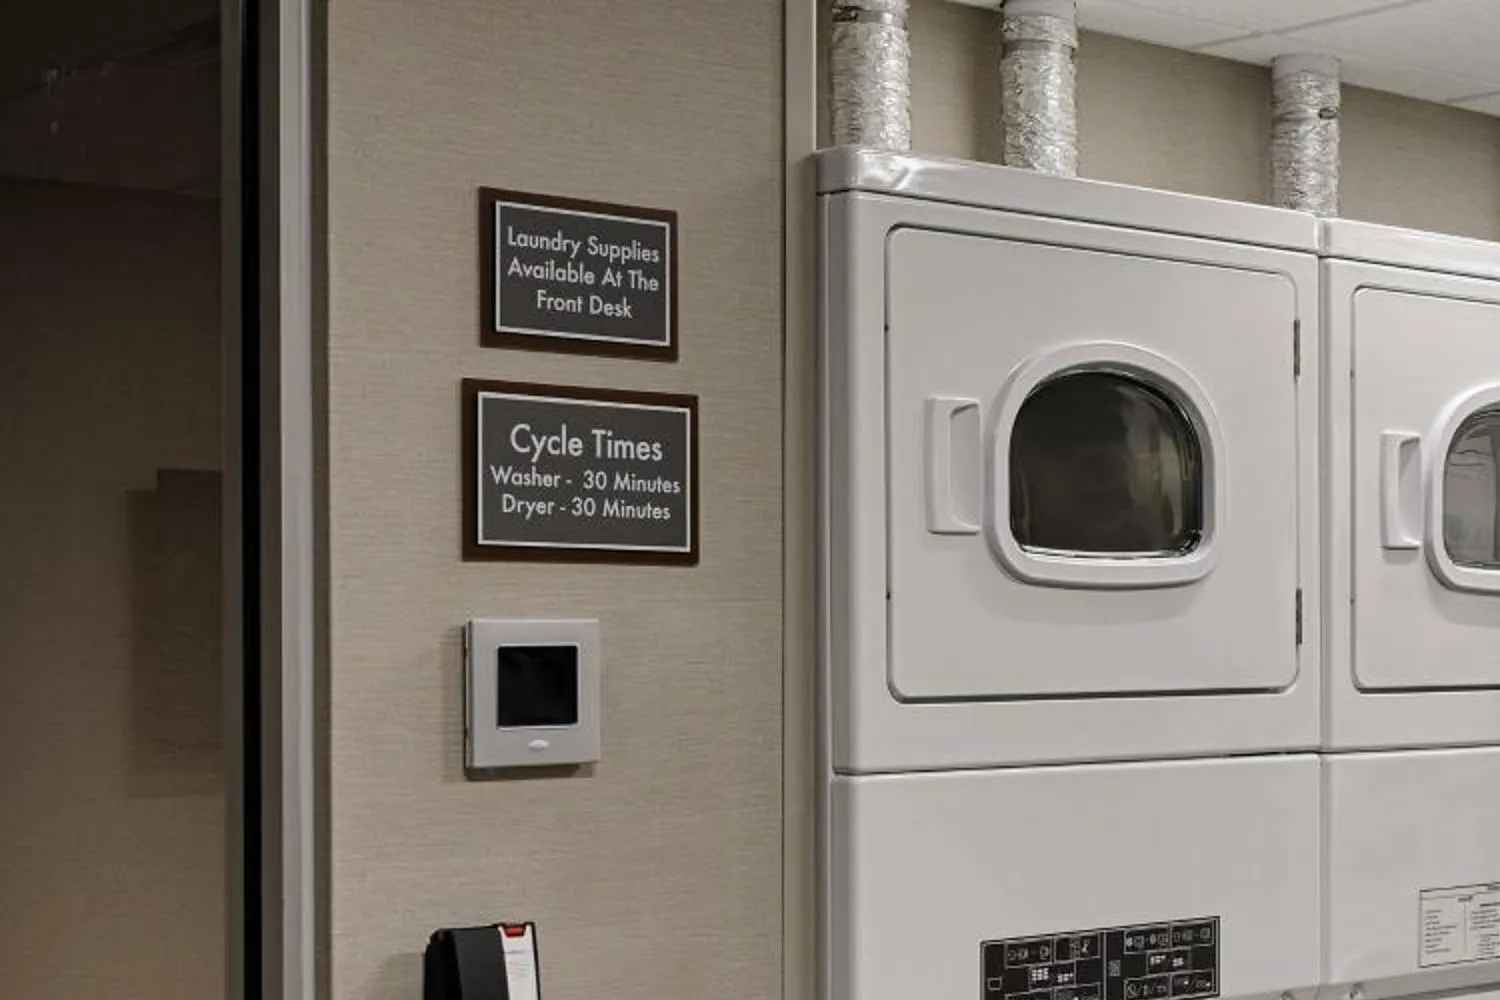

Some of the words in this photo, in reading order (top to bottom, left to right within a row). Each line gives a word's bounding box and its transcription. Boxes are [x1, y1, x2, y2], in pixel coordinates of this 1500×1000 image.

[507, 226, 581, 257] Laundry
[587, 236, 660, 265] Supplies
[507, 256, 595, 285] Available
[602, 268, 622, 288] At
[628, 269, 659, 291] The
[537, 290, 583, 313] Front
[590, 295, 633, 319] Desk
[510, 423, 583, 463] Cycle
[591, 429, 663, 461] Times
[490, 464, 561, 487] Washer
[583, 470, 607, 491] 30
[613, 472, 681, 493] Minutes
[502, 494, 555, 520] Dryer
[571, 498, 596, 517] 30
[603, 500, 671, 520] Minutes
